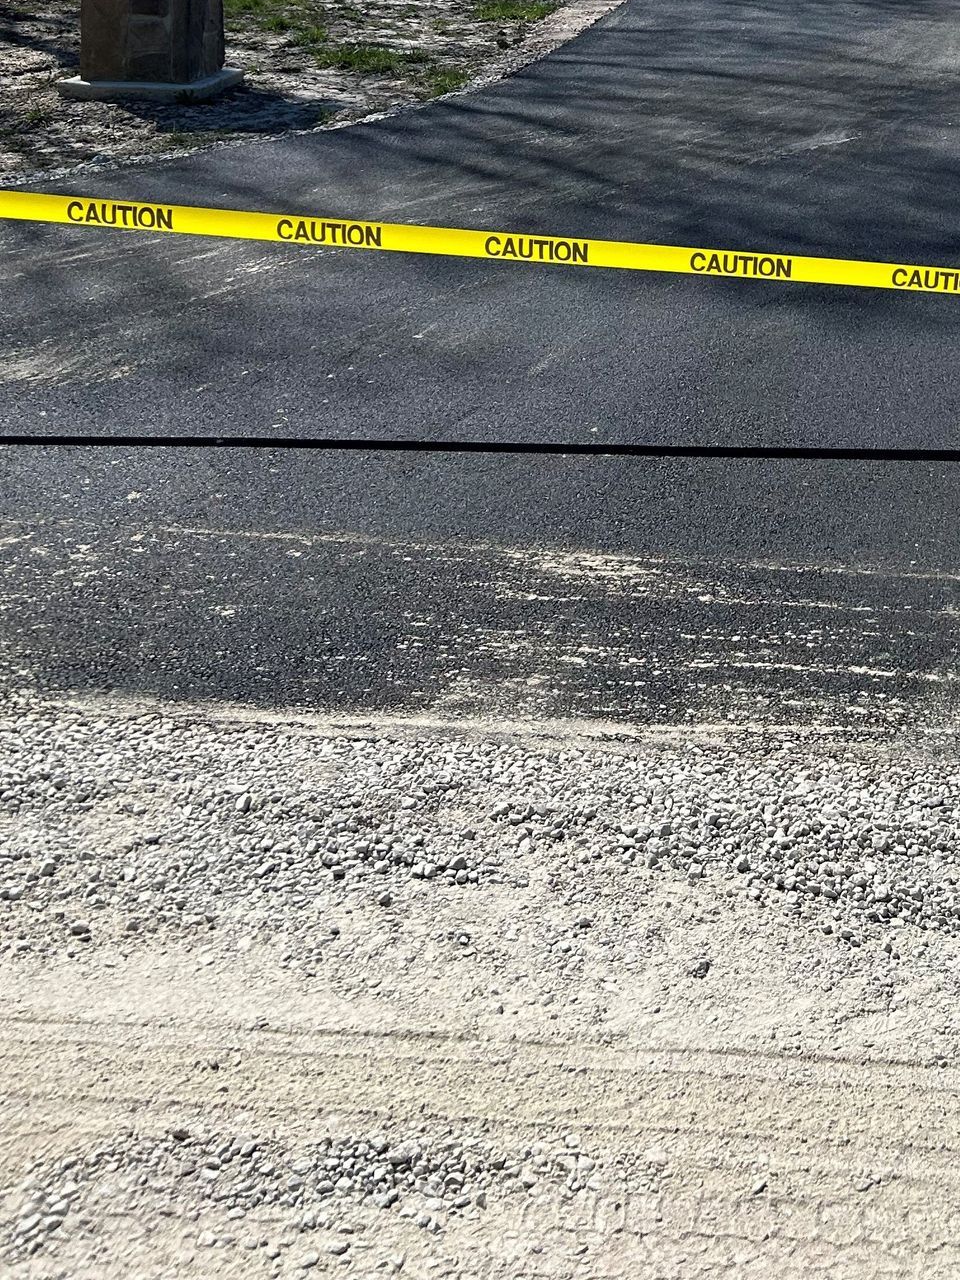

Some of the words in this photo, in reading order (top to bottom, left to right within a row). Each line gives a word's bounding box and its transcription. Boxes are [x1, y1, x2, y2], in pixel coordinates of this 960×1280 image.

[67, 201, 173, 229] CAUTION
[276, 219, 382, 245] CAUTION
[484, 235, 589, 262] CAUTION
[690, 252, 792, 278] CAUTION
